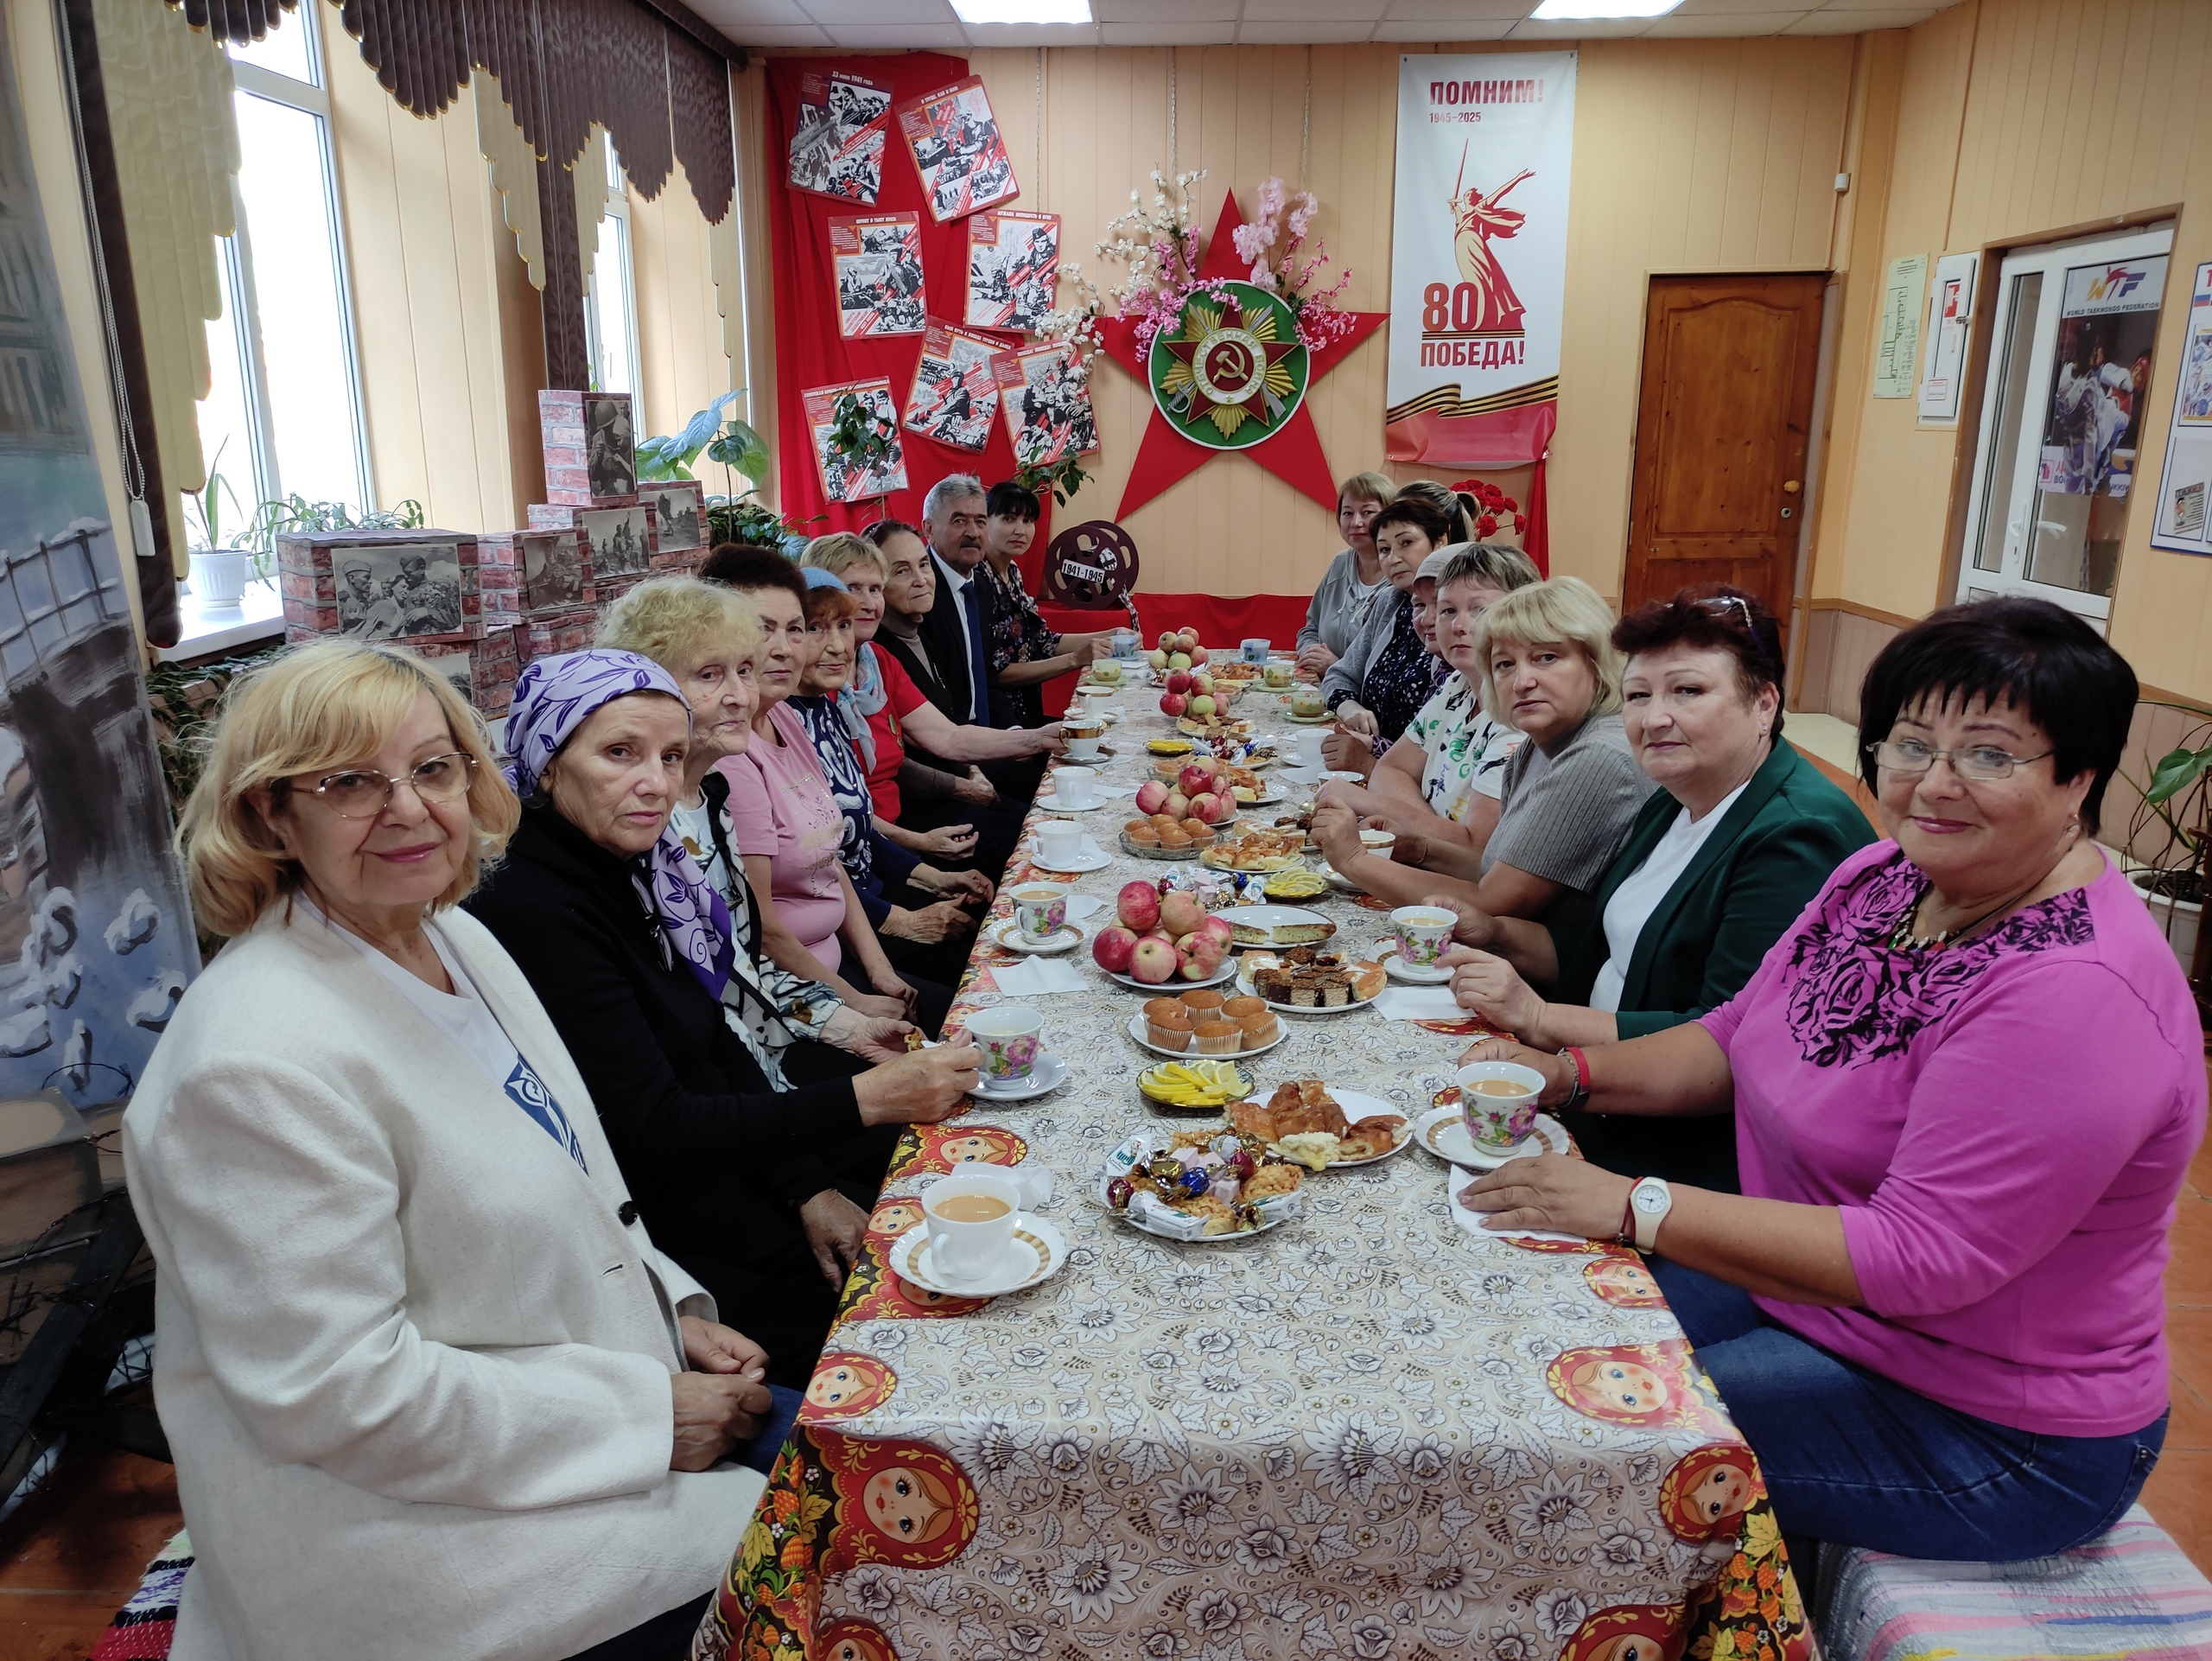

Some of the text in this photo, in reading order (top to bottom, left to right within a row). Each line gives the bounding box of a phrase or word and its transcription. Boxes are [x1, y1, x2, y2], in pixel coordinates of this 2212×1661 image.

[1430, 80, 1544, 105] ПОМНИМ!
[1422, 282, 1479, 332] 80
[2087, 305, 2120, 315] TAEKWONDO
[1195, 330, 1264, 396] ОТЕЧЕСТВЕННАЯ ВОЙНА
[1421, 340, 1525, 370] ПОБЕДА!
[1063, 563, 1103, 583] 1941-1945
